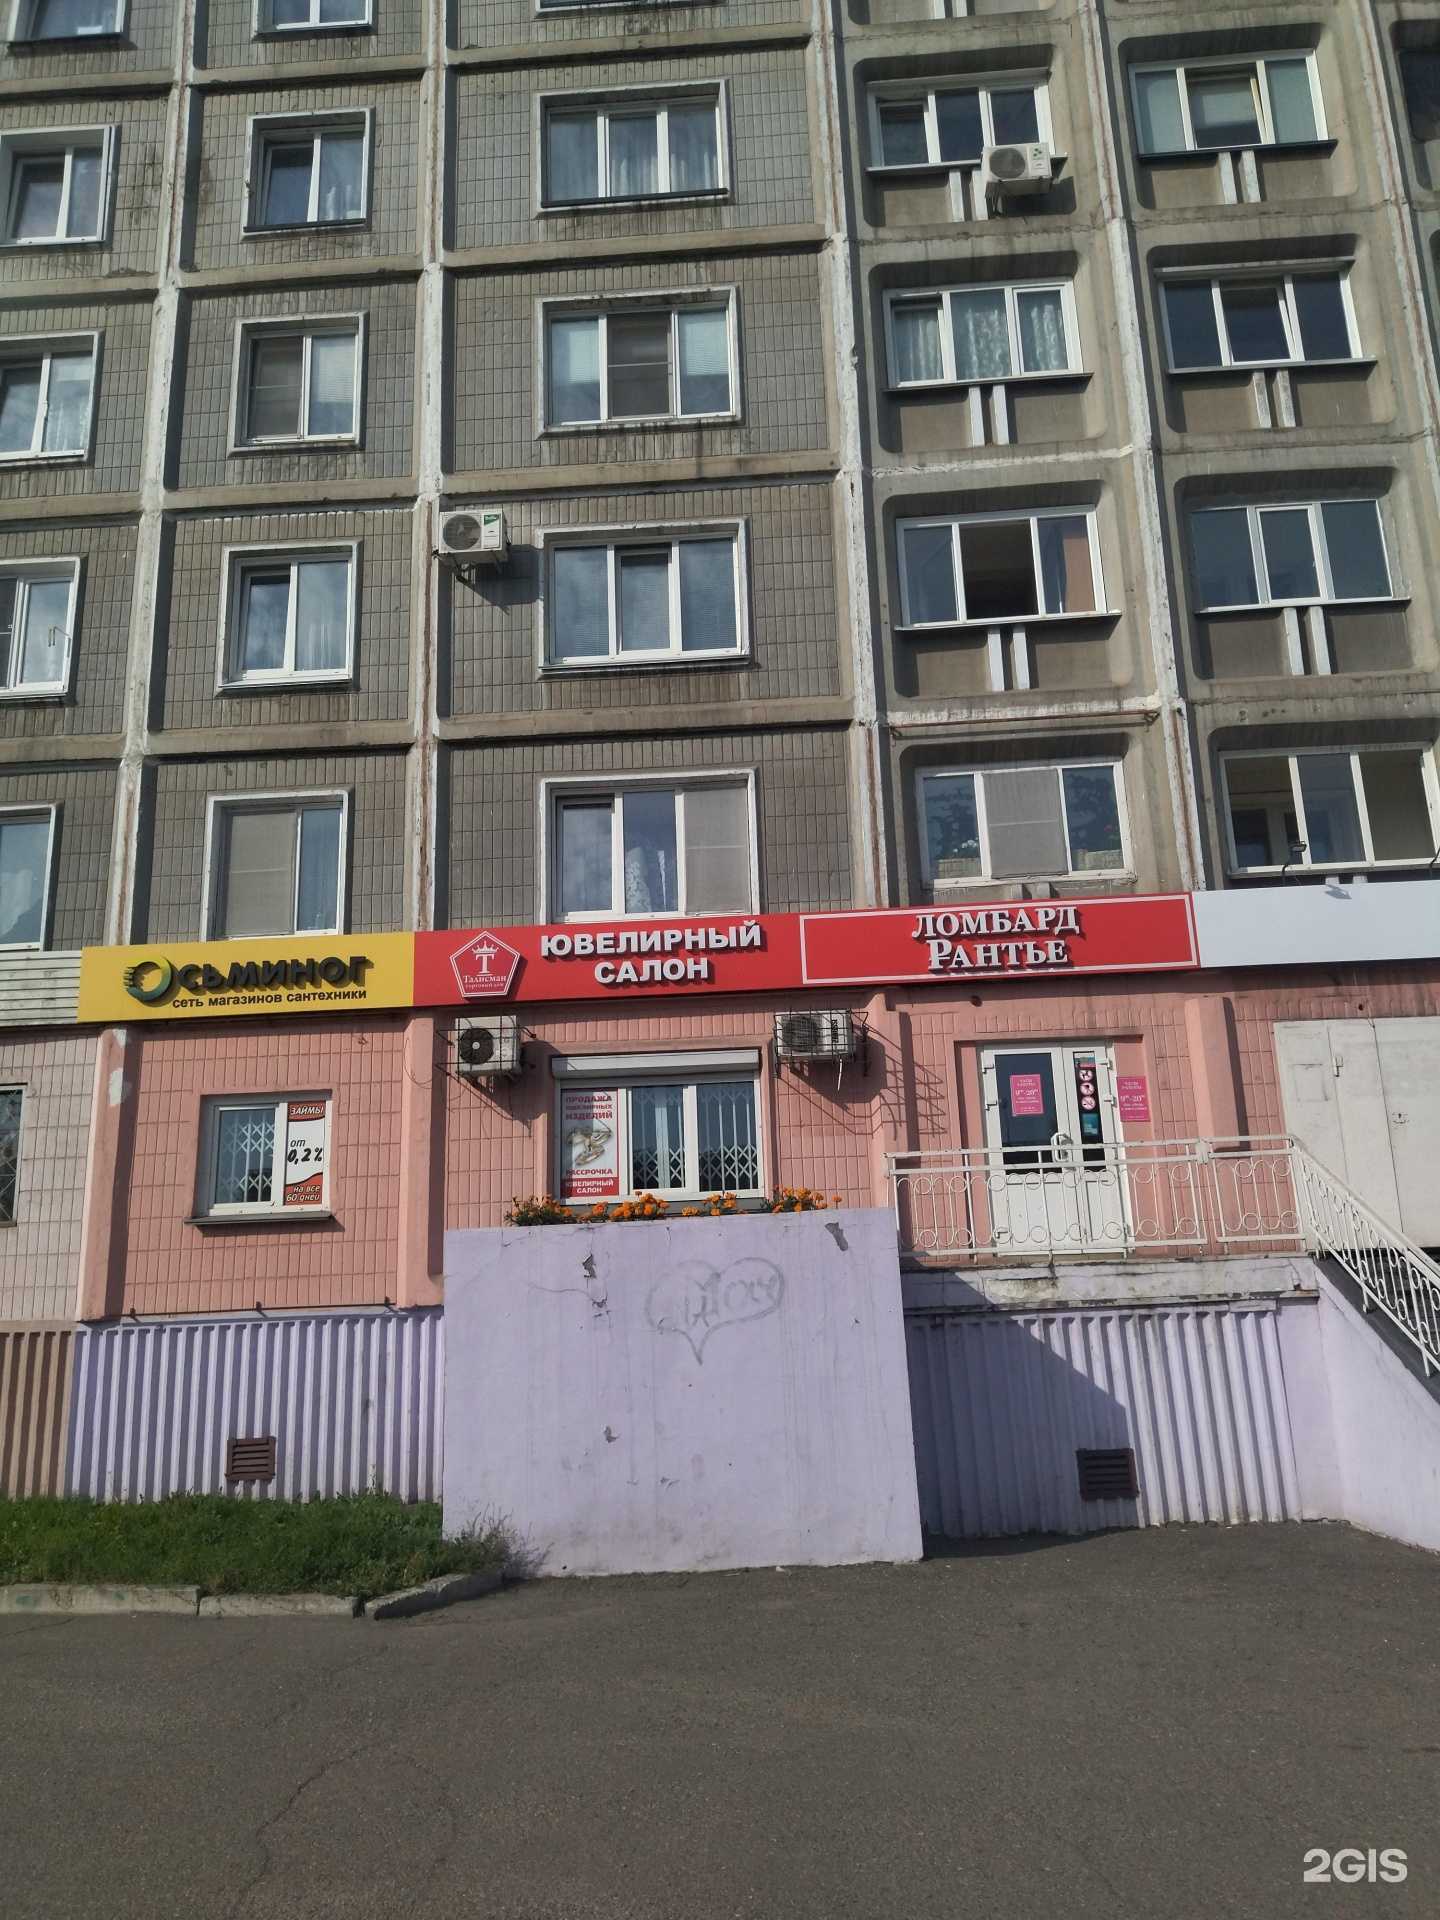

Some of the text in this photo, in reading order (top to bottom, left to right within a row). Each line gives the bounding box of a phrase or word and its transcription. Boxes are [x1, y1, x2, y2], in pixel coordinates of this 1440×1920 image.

[911, 906, 1080, 938] ЛОМБАРД
[540, 919, 762, 957] ЮВЕЛИРНЫЙ
[594, 957, 709, 984] САЛОН
[172, 989, 368, 1009] сеть магазинов сантехники
[290, 1106, 324, 1116] ЗАЙМЫ
[290, 1139, 306, 1148] от
